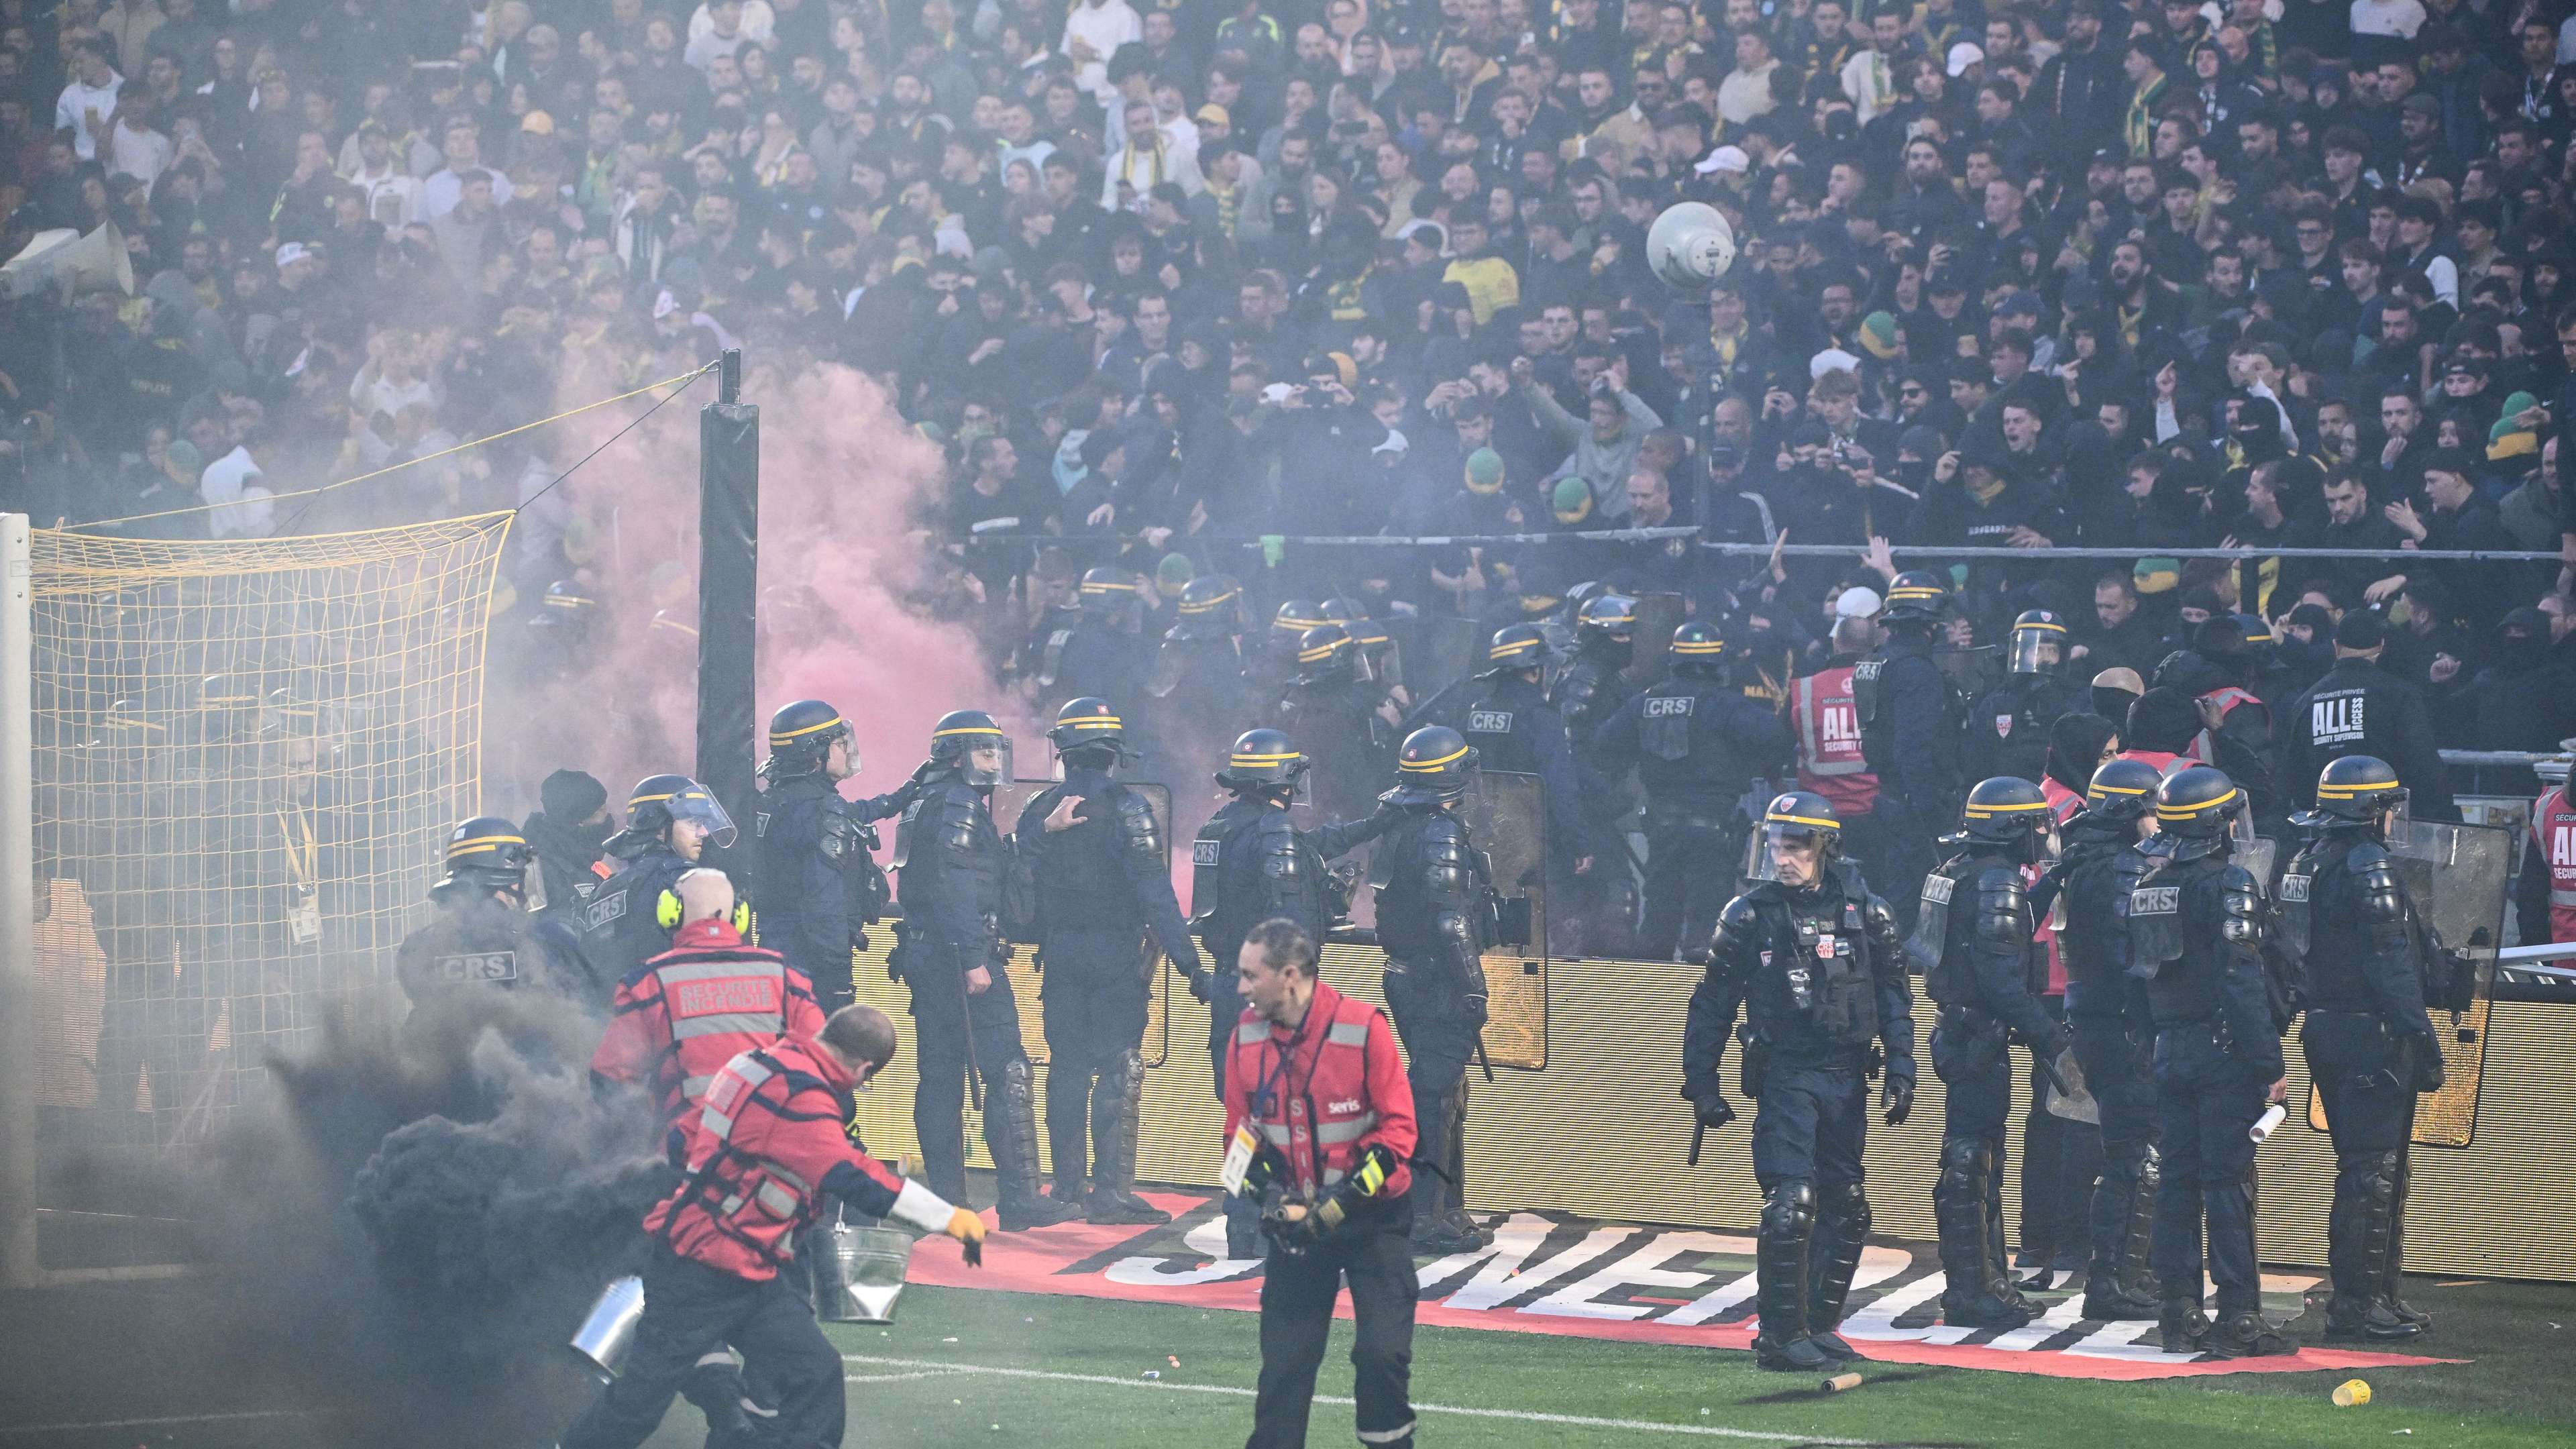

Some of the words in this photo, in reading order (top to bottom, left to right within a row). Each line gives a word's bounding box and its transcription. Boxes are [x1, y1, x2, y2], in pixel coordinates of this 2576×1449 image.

[1855, 663, 1875, 680] CRS
[1649, 699, 1686, 715] CRS
[2351, 697, 2363, 731] ACCESS
[1472, 713, 1505, 731] CRS
[2312, 698, 2351, 737] ALL
[1825, 740, 1857, 752] SECURITY
[1195, 844, 1215, 863] CRS
[2282, 877, 2308, 898] CRS
[590, 896, 619, 926] CRS
[2135, 890, 2174, 912] CRS
[1817, 943, 1833, 951] CRS
[444, 956, 506, 978] CRS
[681, 993, 773, 1014] INCENDIE
[1328, 1097, 1361, 1115] seris
